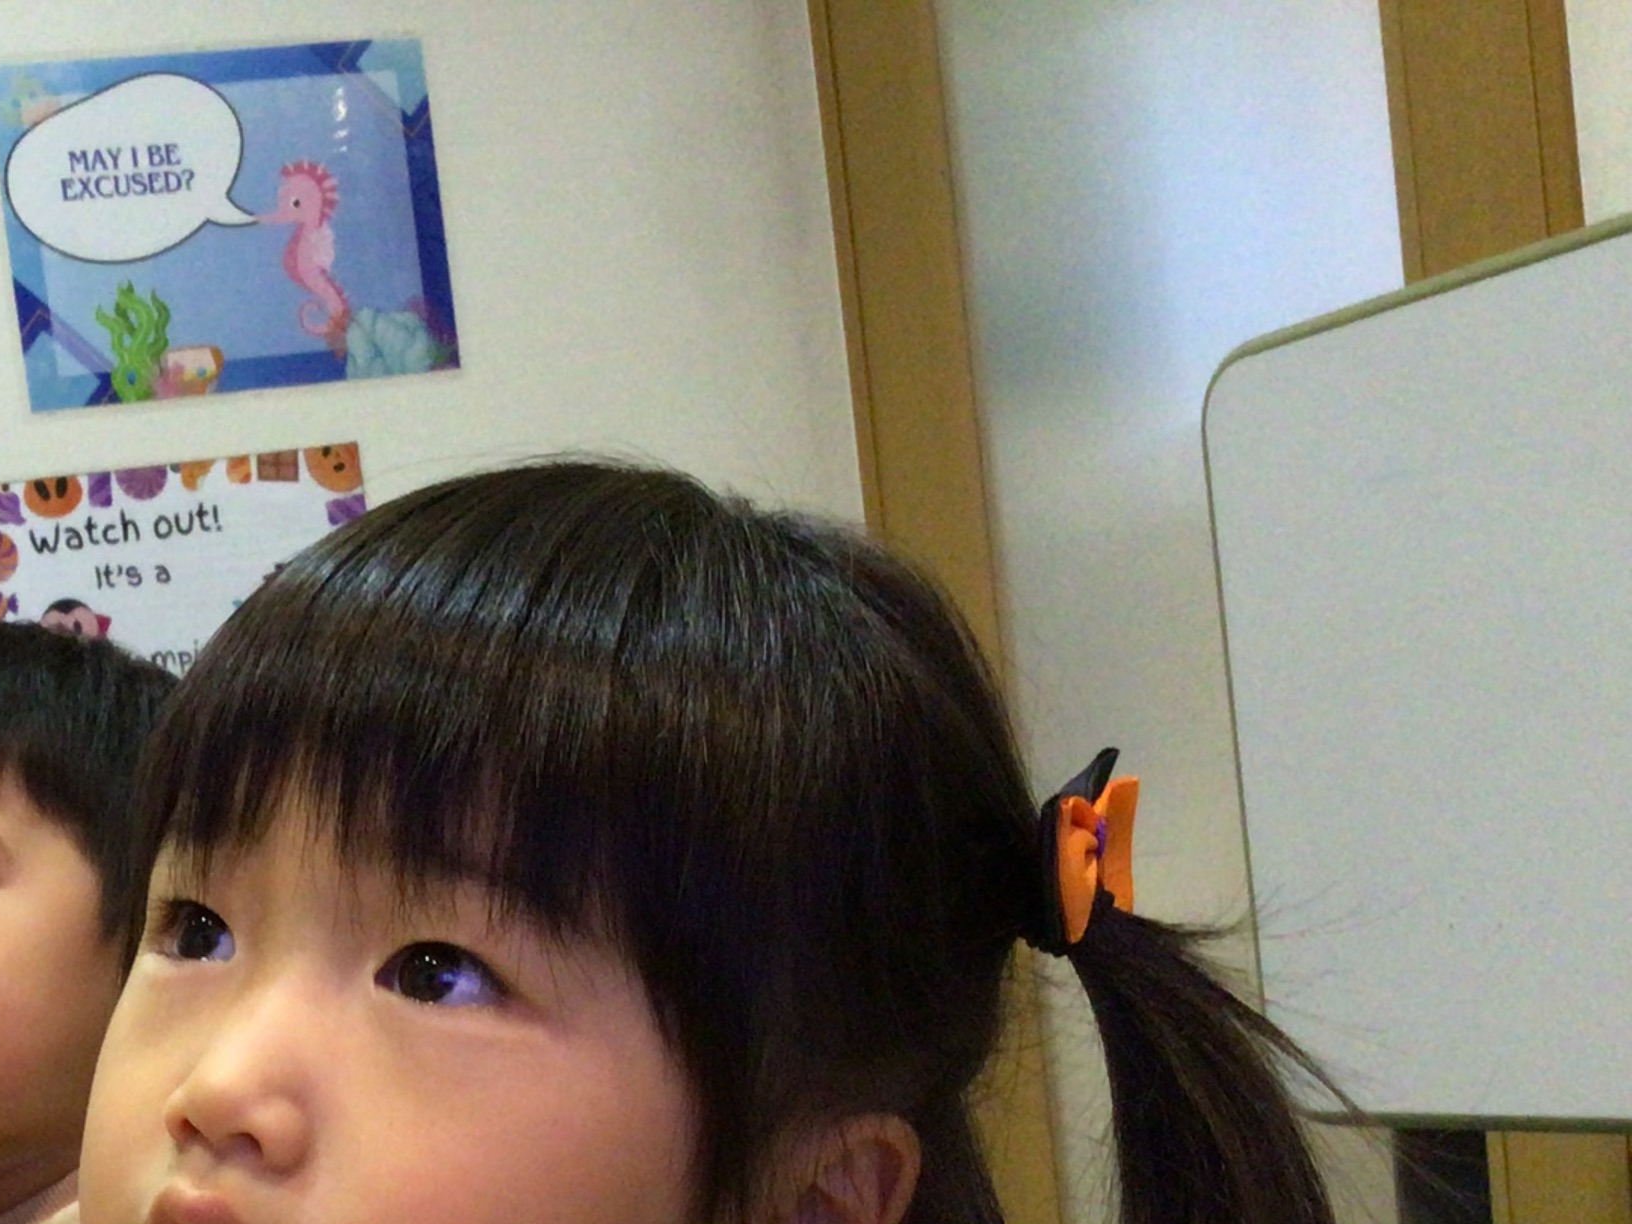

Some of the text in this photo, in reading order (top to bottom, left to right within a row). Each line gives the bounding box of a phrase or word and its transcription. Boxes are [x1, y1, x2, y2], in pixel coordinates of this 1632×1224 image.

[68, 142, 181, 173] MAY I BE
[60, 168, 195, 201] EXCUSED?
[29, 502, 224, 555] Watch out!
[94, 563, 172, 590] It's a
[133, 639, 200, 676] mpi
